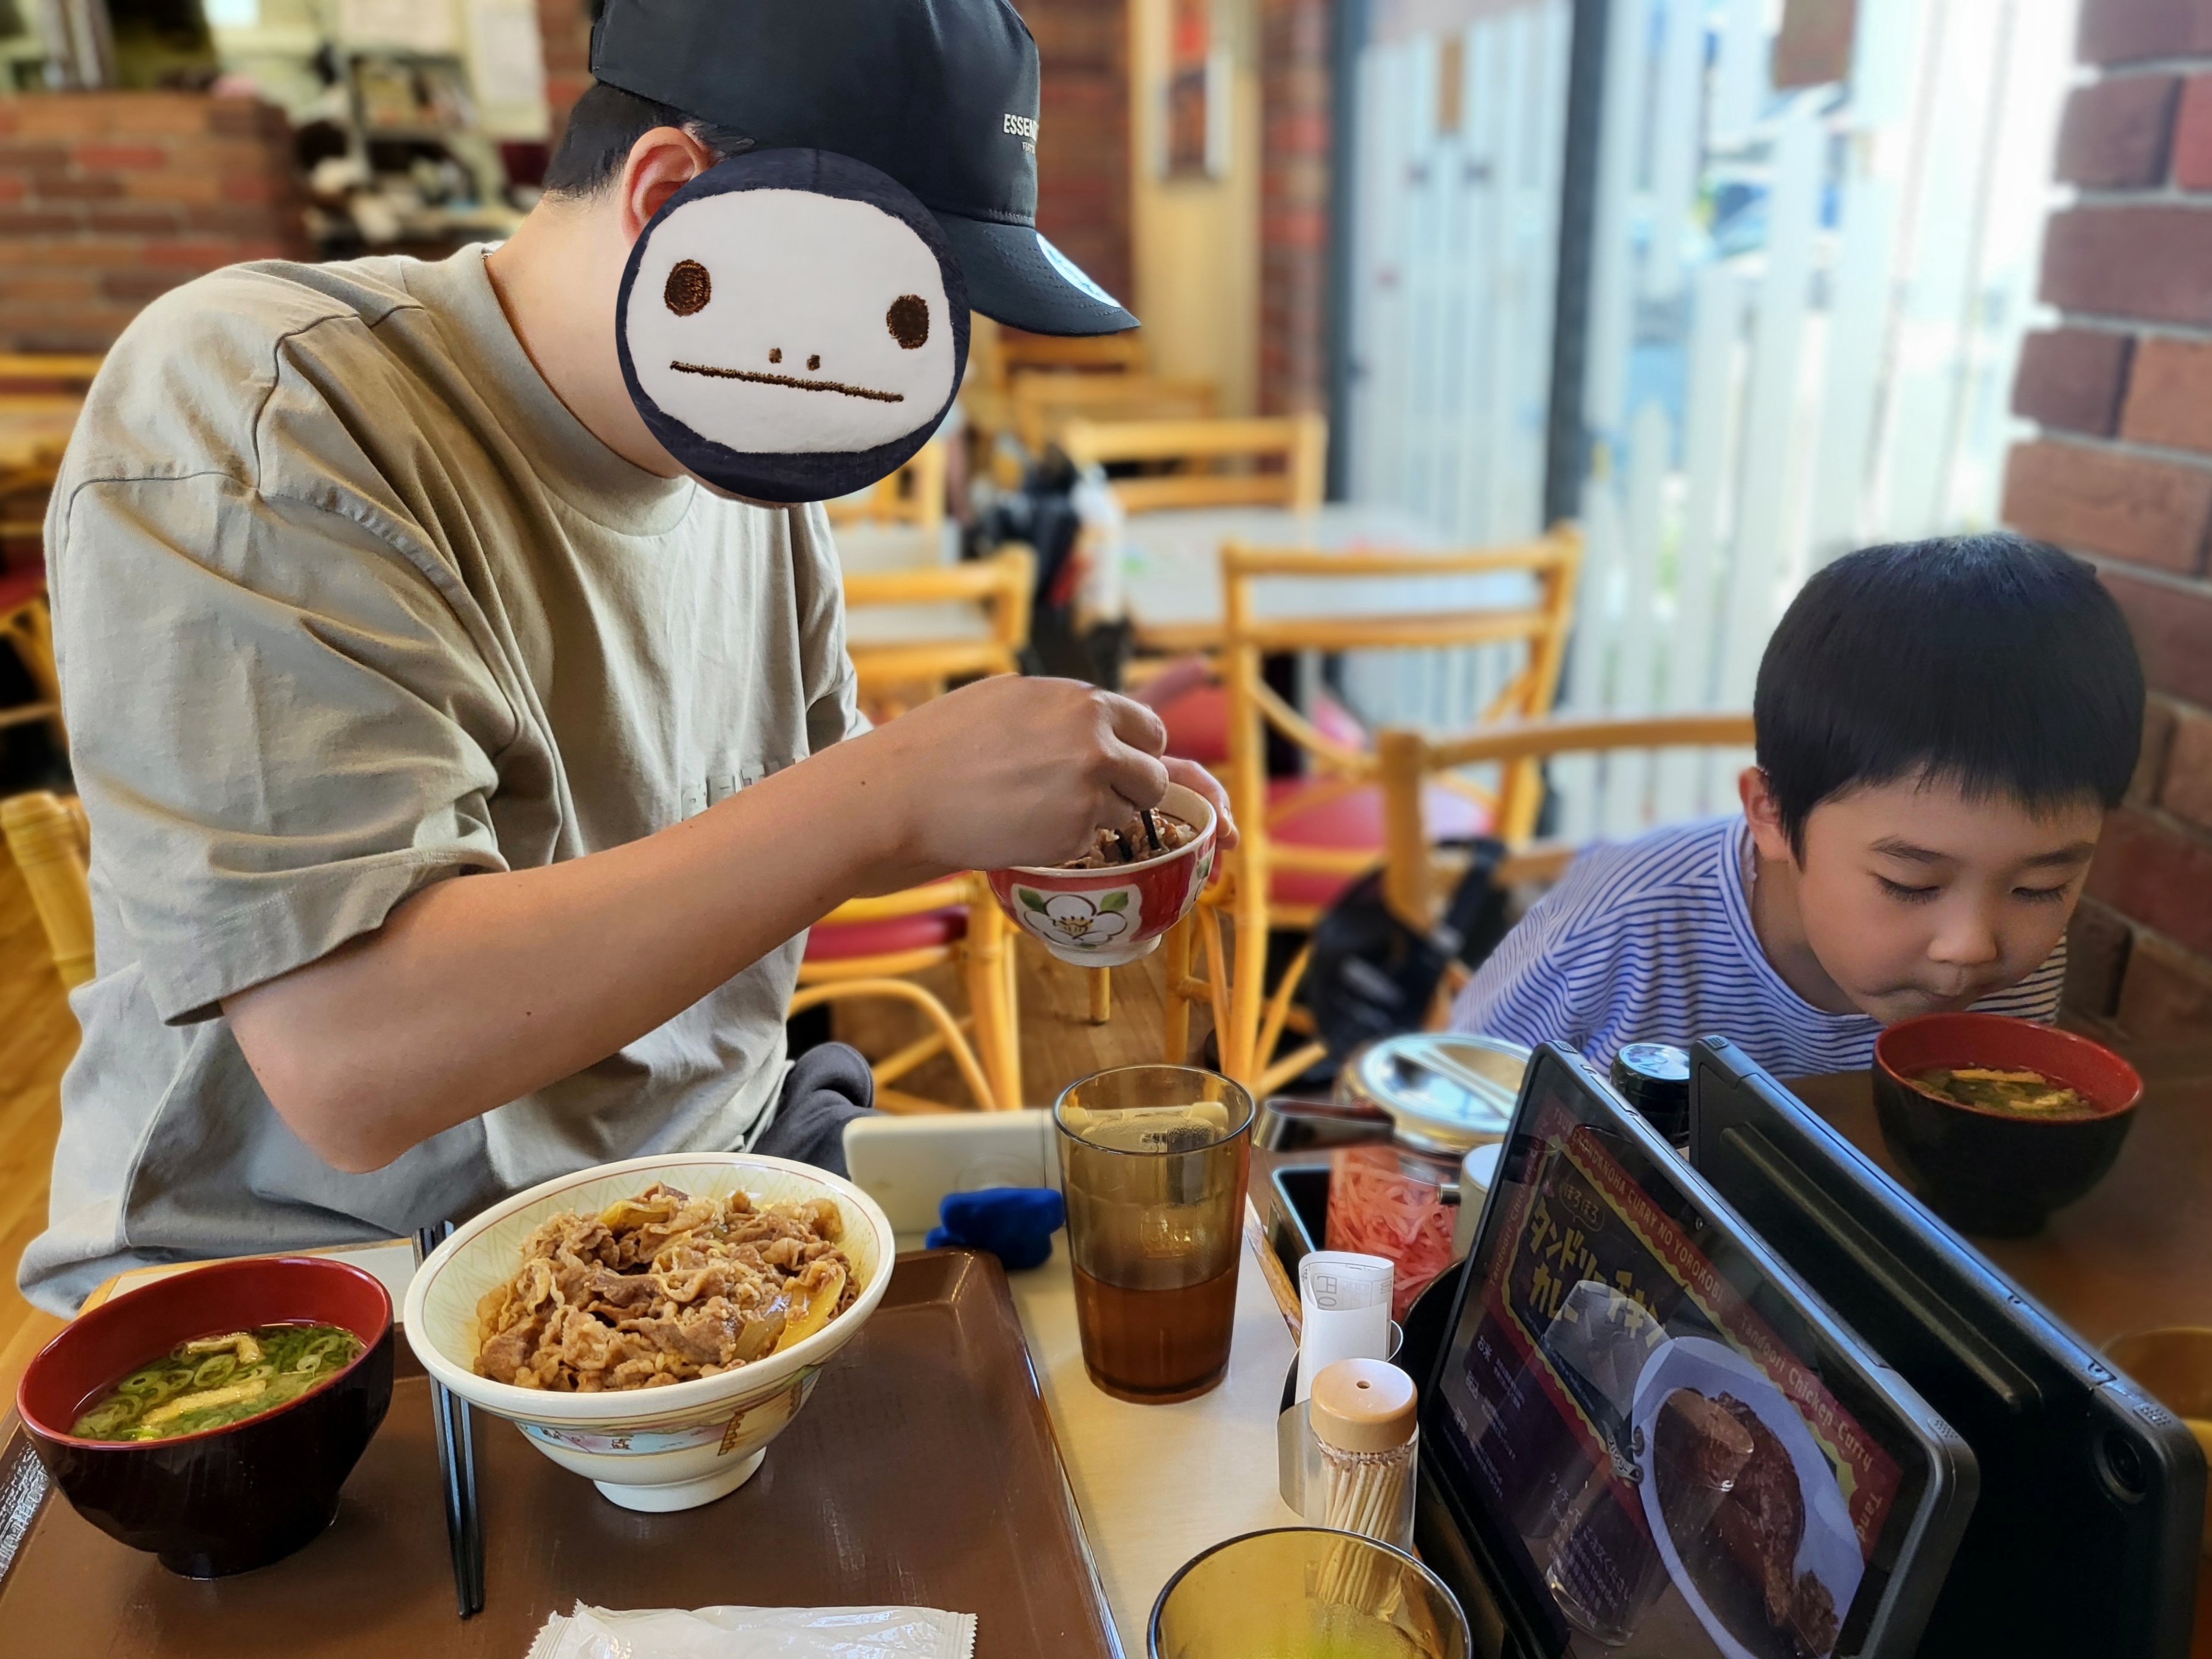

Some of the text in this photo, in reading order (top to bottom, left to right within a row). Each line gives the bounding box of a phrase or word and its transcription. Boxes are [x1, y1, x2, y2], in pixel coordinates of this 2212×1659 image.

[1564, 1183, 1599, 1224] ほろほろ
[1490, 1228, 1512, 1286] Tandoori
[1627, 1189, 1658, 1229] CURRY
[1657, 1222, 1674, 1248] NO
[1671, 1238, 1724, 1303] YOROKOBI
[1529, 1260, 1578, 1324] カレー
[1477, 1334, 1492, 1361] お米
[1740, 1314, 1874, 1474] Tandoori Chicken Curry
[1596, 1576, 1618, 1611] order
